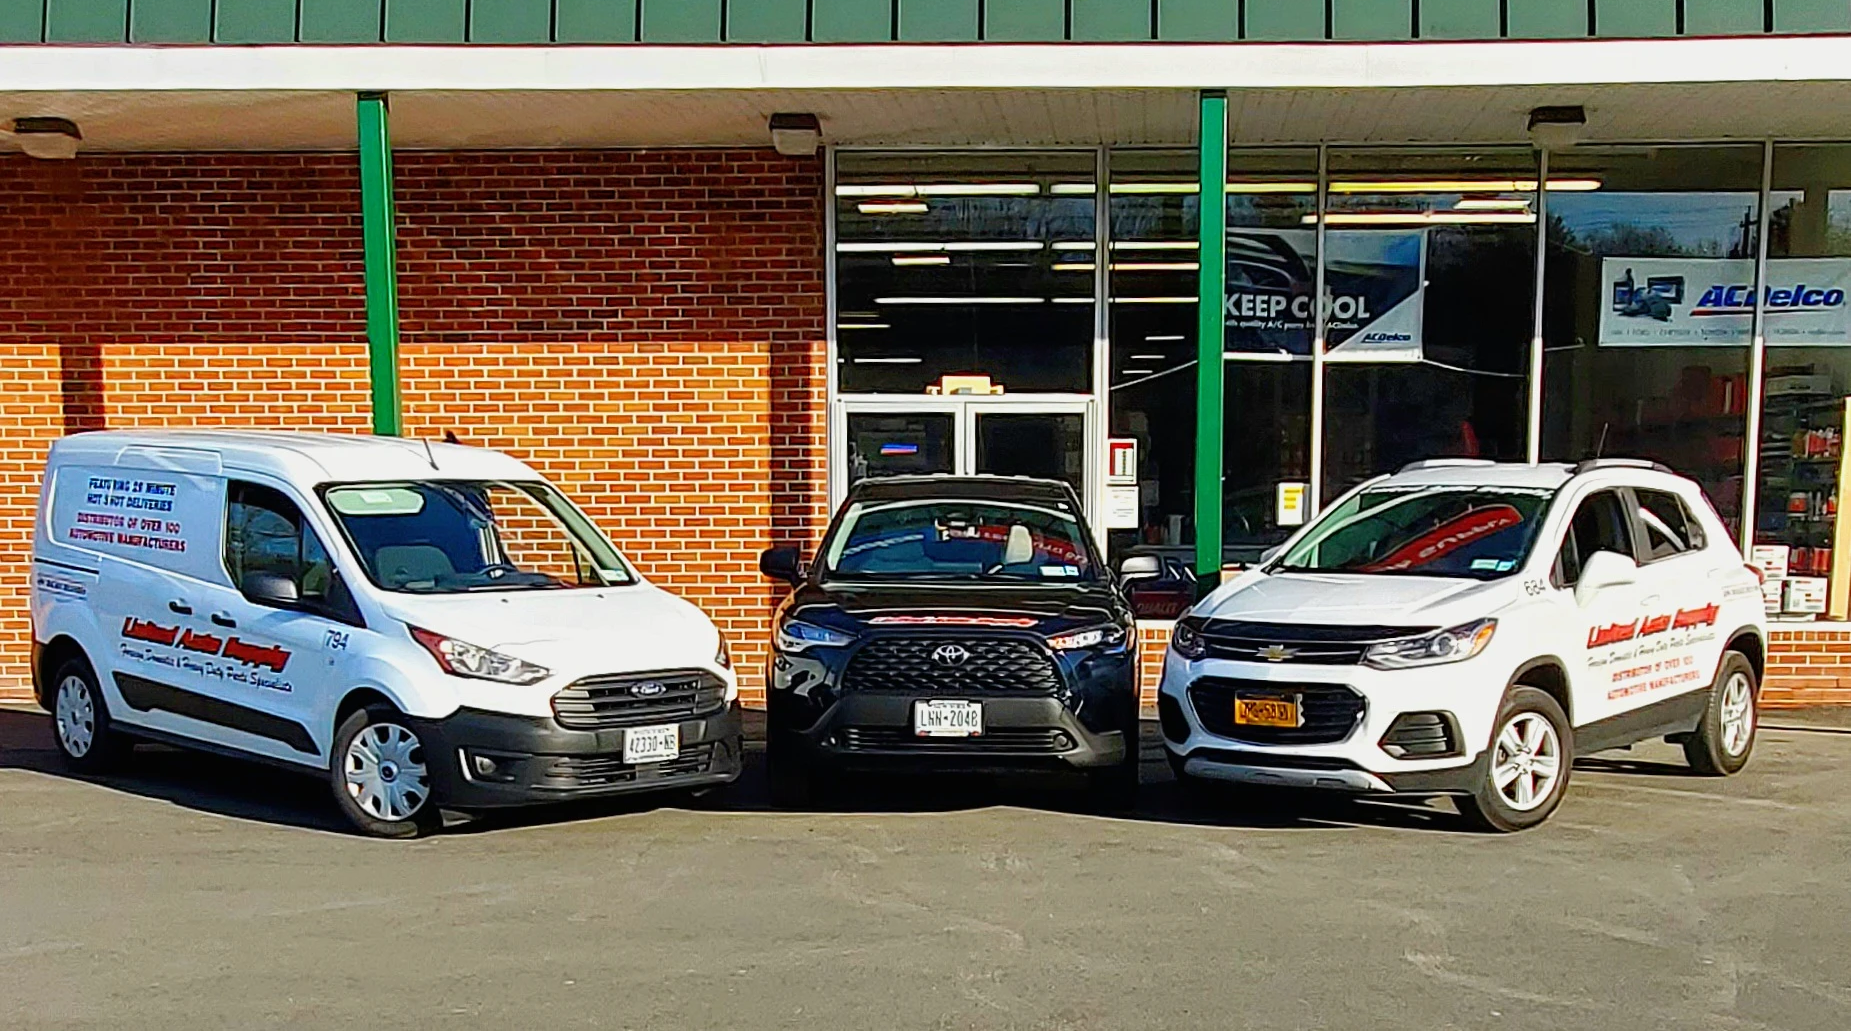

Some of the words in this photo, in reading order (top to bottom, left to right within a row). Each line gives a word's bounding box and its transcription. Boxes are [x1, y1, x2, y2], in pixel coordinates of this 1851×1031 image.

[1224, 293, 1287, 318] KEEP
[1291, 295, 1370, 319] COOL
[1362, 333, 1411, 343] ACDelco
[121, 617, 180, 647] United
[175, 628, 223, 656] Auto
[326, 629, 349, 650] 794
[1586, 617, 1639, 649] United
[1636, 614, 1672, 639] Auto
